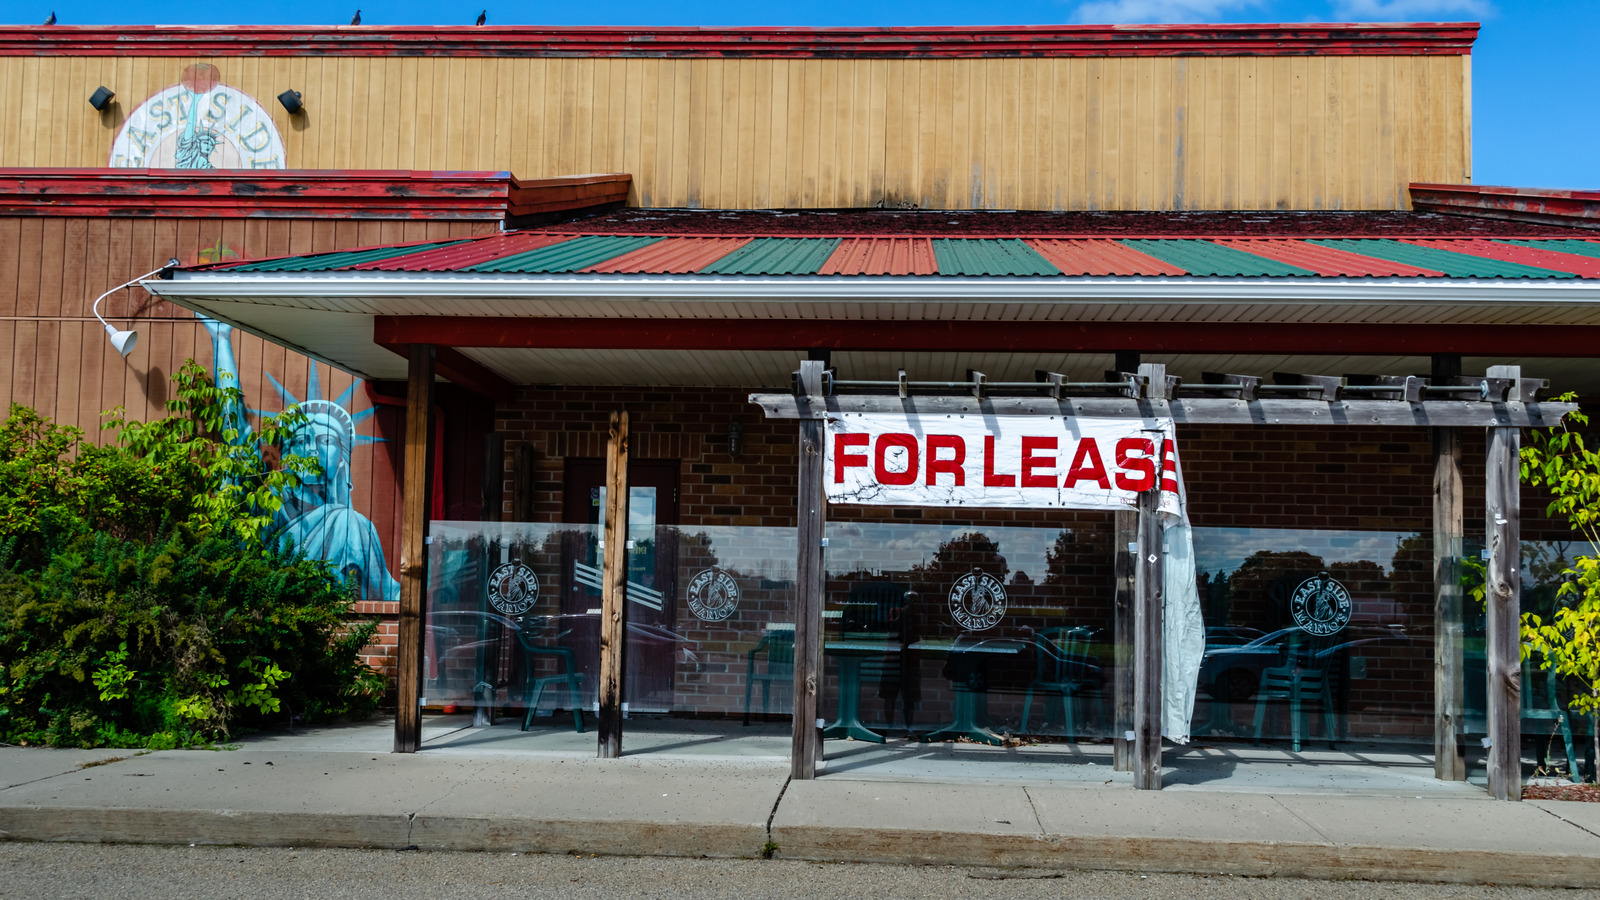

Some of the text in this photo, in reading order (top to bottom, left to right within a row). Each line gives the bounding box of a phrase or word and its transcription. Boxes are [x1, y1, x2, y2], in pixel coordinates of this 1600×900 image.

[834, 433, 966, 486] FOR
[490, 565, 537, 591] EAST SIDE
[690, 571, 737, 598] EAST SIDE
[951, 575, 1005, 603] EAST SIDE
[490, 591, 535, 613] MARIO'S
[1294, 579, 1350, 609] EAST SIDE
[690, 598, 735, 620] MARIO'S
[953, 606, 1004, 628] MARIO'S
[1294, 609, 1348, 634] MARIO'S
